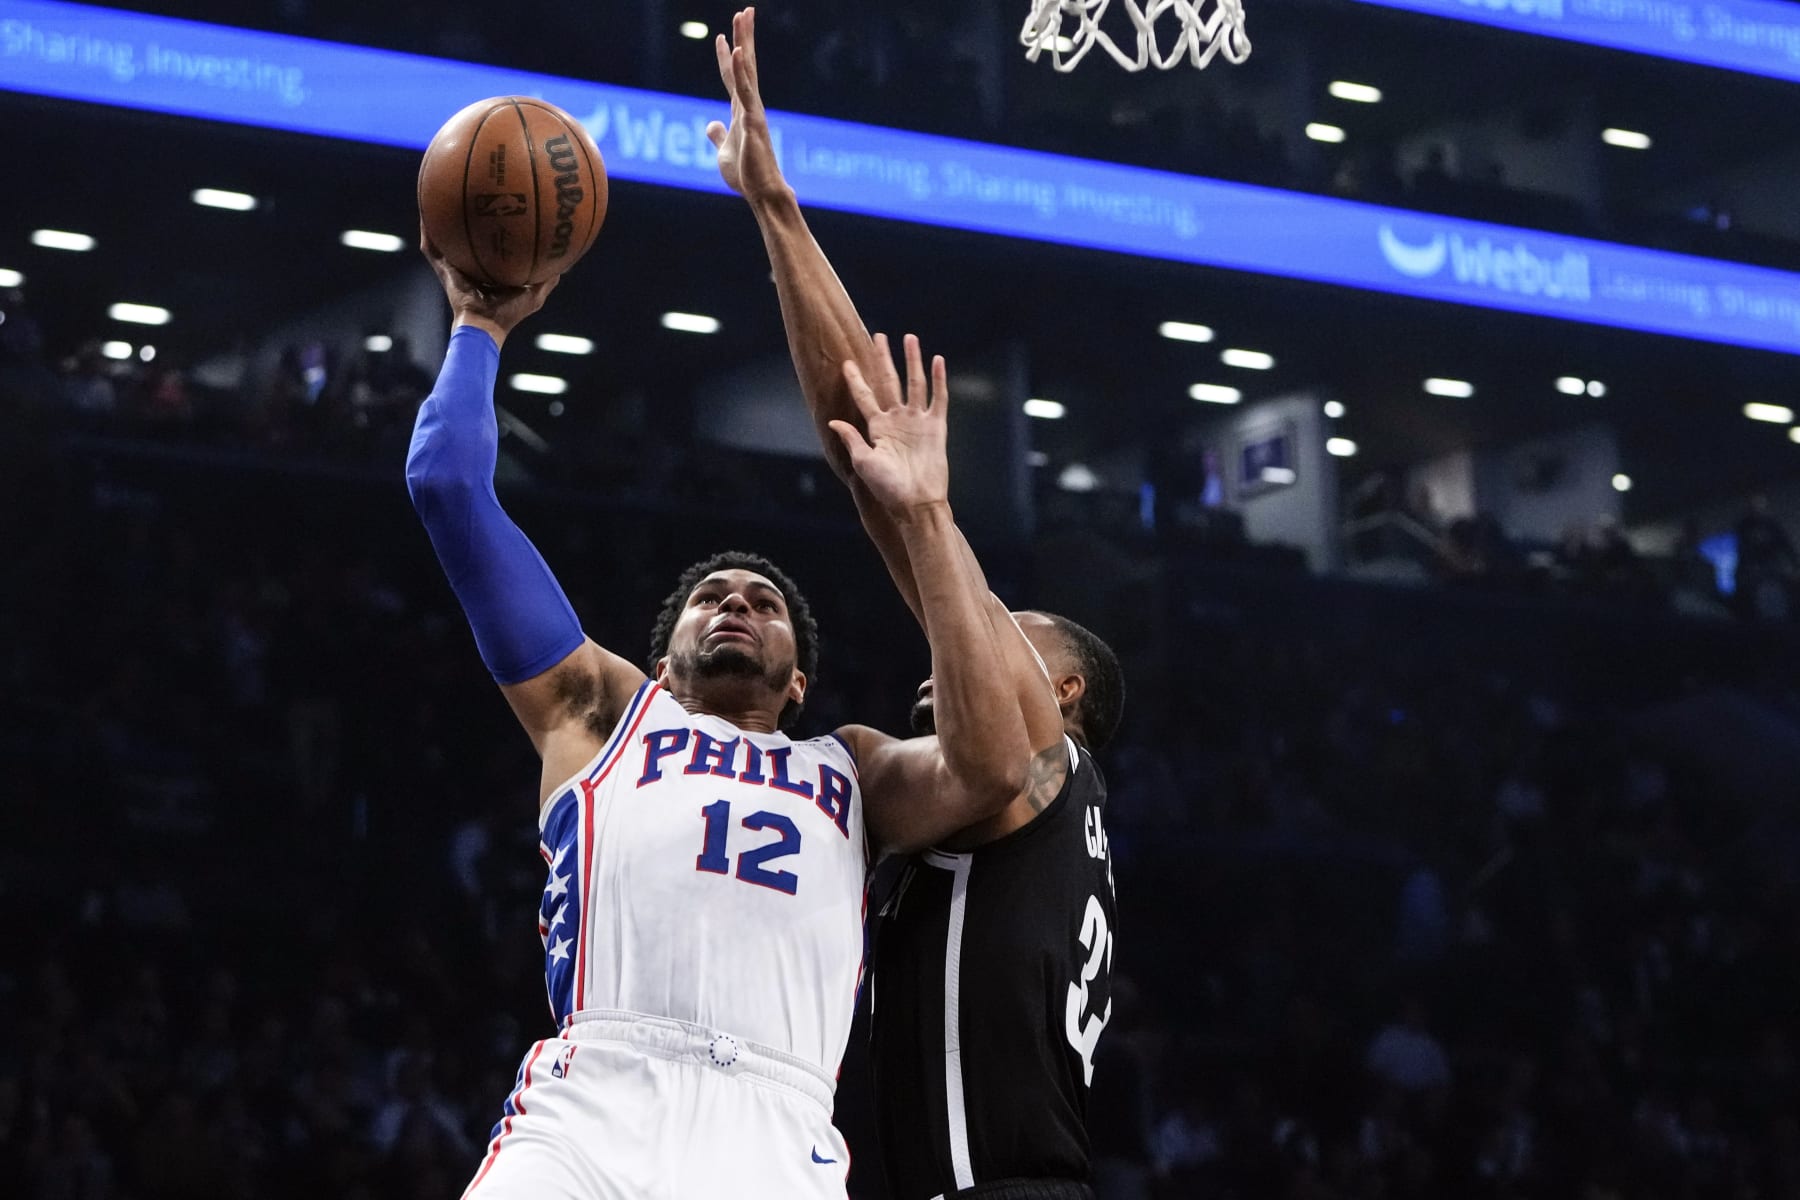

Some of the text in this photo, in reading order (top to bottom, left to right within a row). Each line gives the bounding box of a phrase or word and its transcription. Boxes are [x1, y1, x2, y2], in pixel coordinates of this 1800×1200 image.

[610, 101, 783, 172] Webl
[544, 134, 584, 261] Wilson
[1449, 230, 1591, 301] Webull
[636, 728, 852, 840] PHILA
[696, 799, 801, 896] 12
